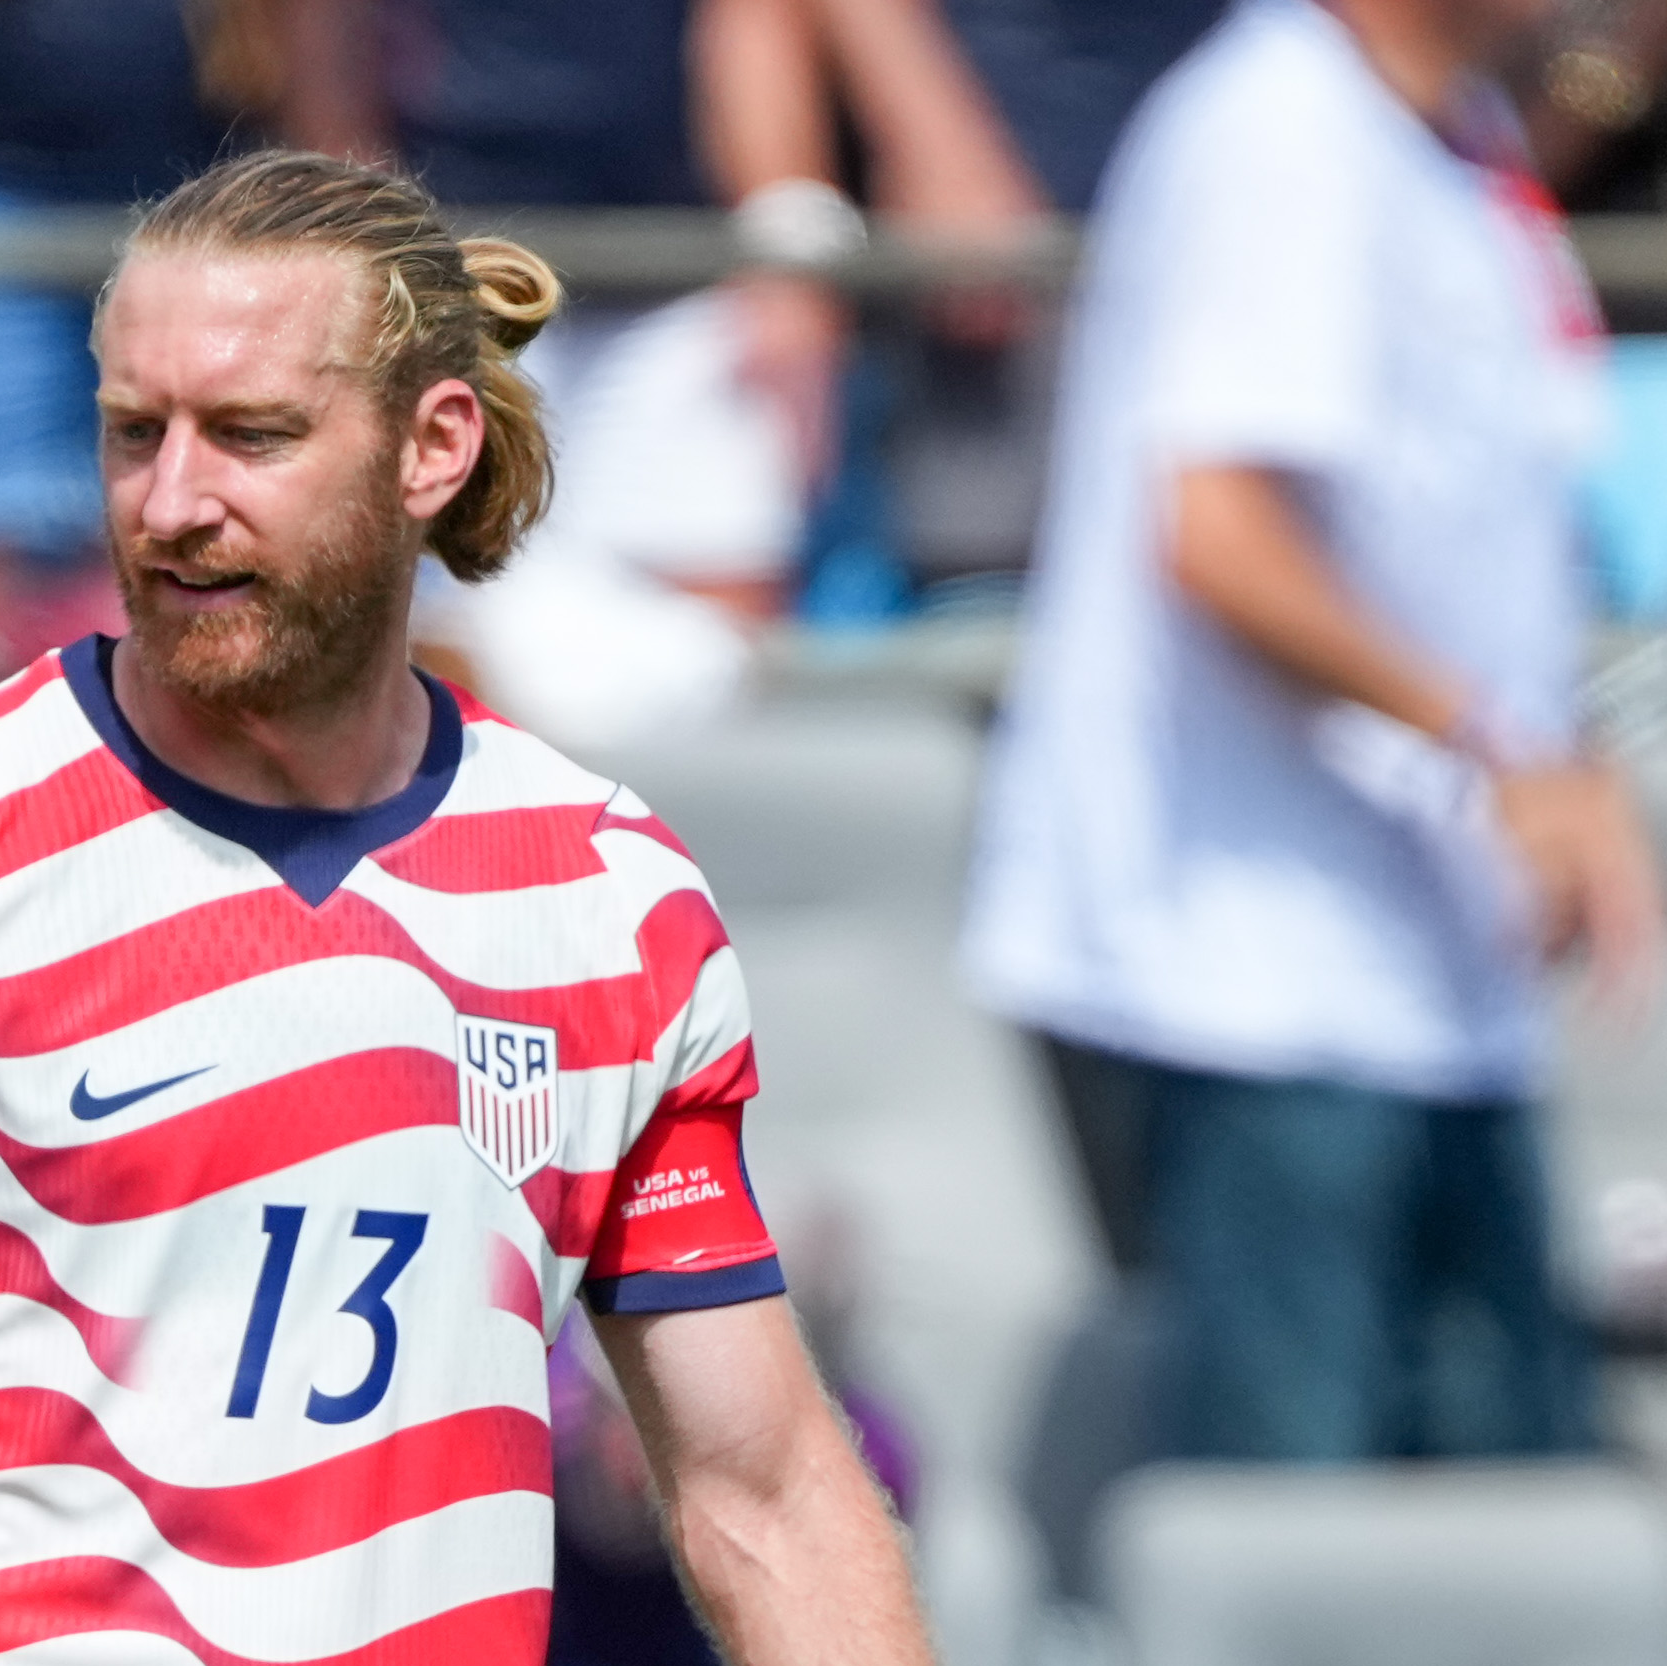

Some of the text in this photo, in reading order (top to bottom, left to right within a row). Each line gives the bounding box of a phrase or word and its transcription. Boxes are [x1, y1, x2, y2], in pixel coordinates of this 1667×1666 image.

[464, 1026, 547, 1091] USA
[621, 1181, 725, 1219] SENEGAL
[634, 1168, 684, 1195] USA
[225, 1204, 430, 1426] 13
